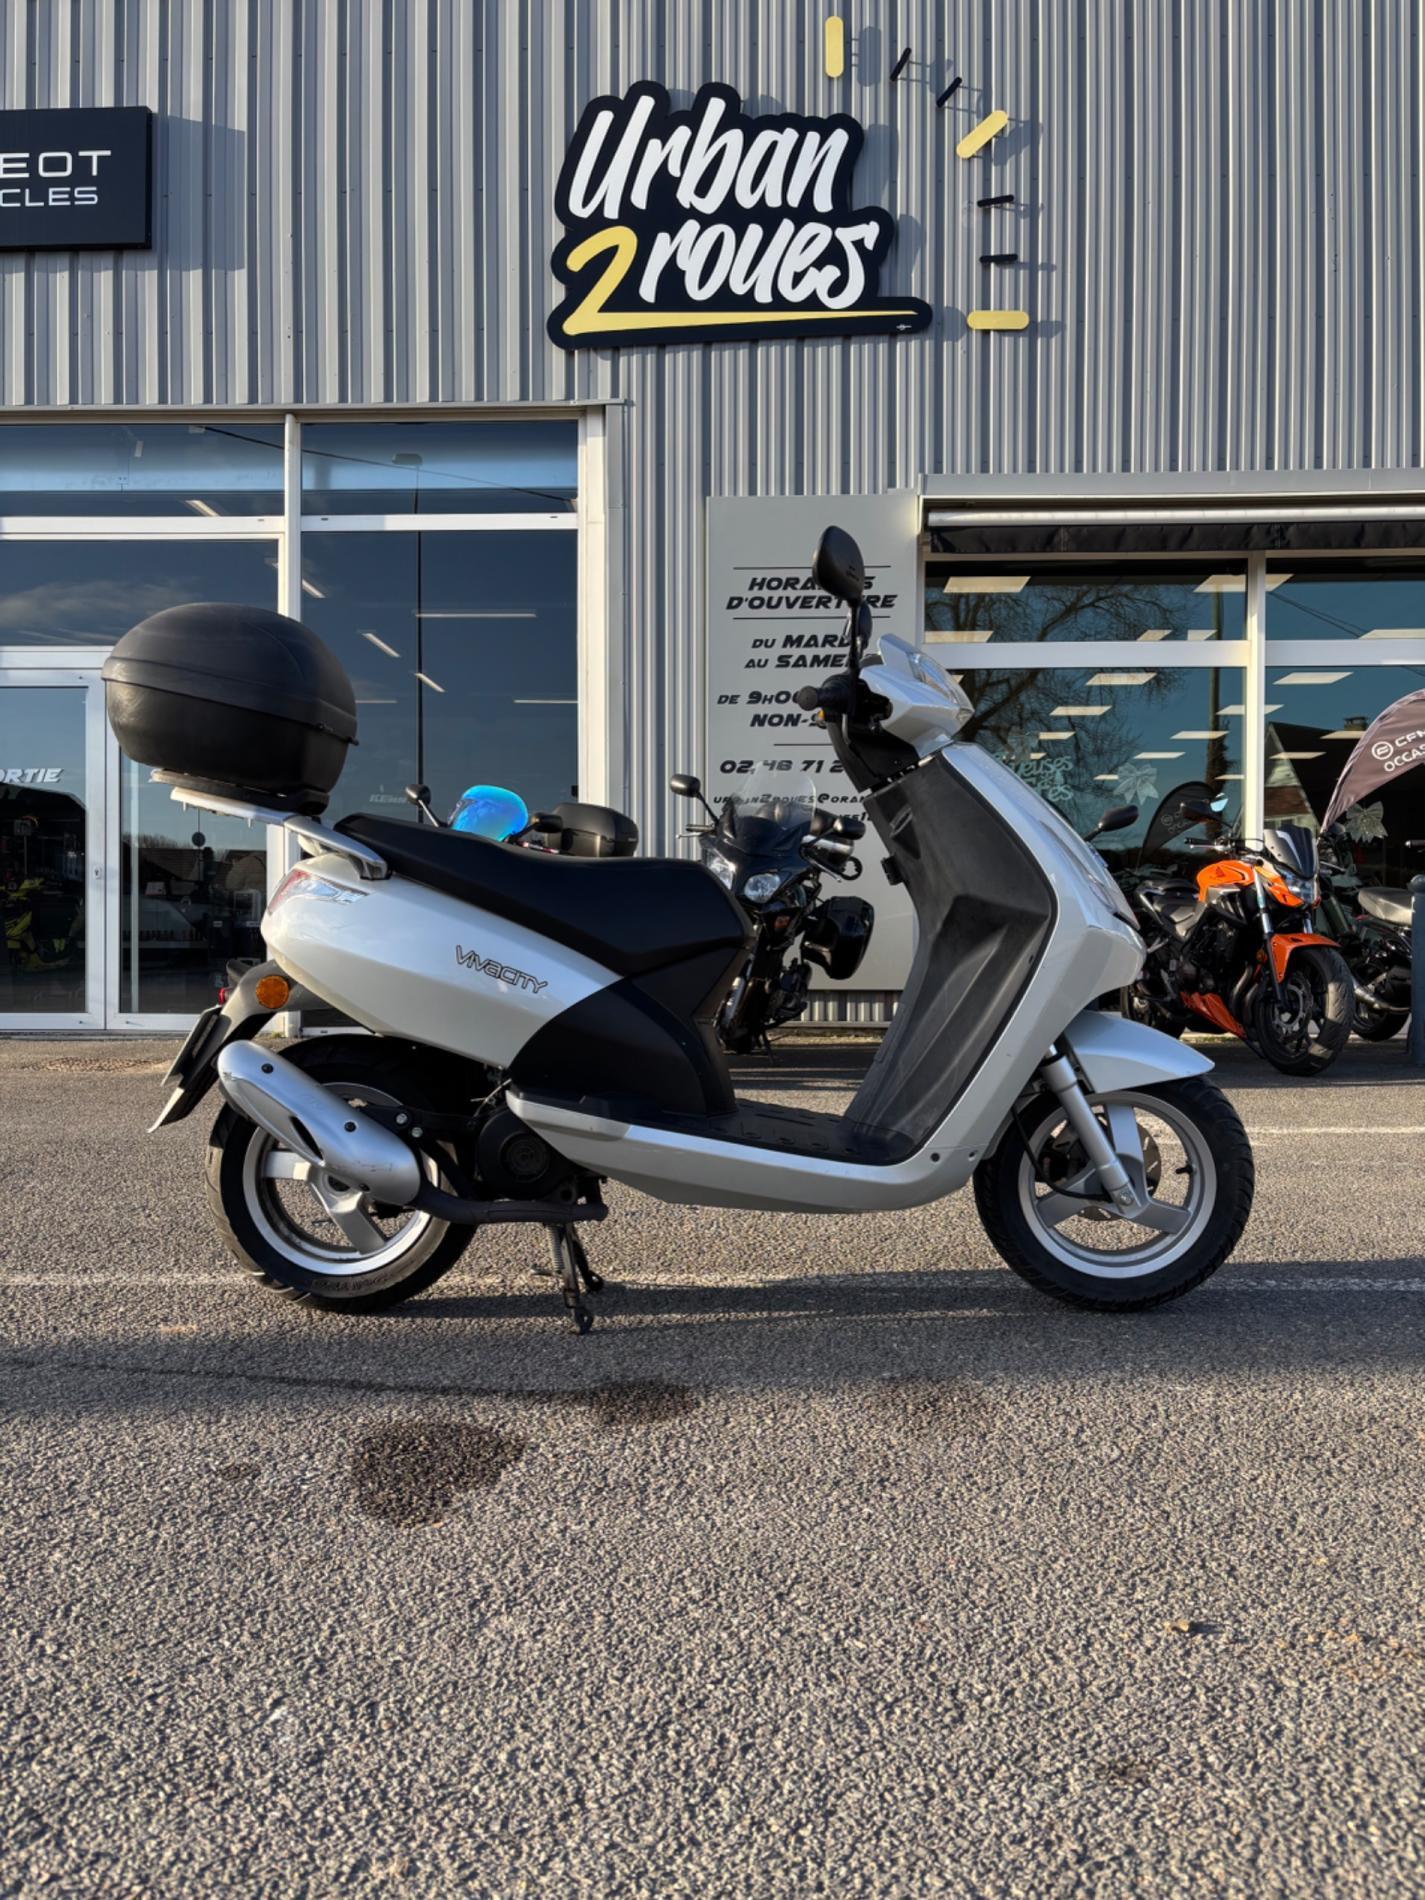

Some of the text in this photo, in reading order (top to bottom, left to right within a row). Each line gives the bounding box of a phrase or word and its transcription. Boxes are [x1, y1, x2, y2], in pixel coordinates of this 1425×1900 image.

[568, 95, 849, 219] Urban
[562, 218, 880, 335] 2 roues
[748, 576, 876, 591] HORAS
[726, 594, 898, 610] D'OUVERTRE
[751, 634, 850, 649] DU MARD
[744, 654, 848, 669] AU SAME
[717, 694, 741, 704] DE
[719, 760, 754, 774] 02
[800, 759, 825, 773] 71
